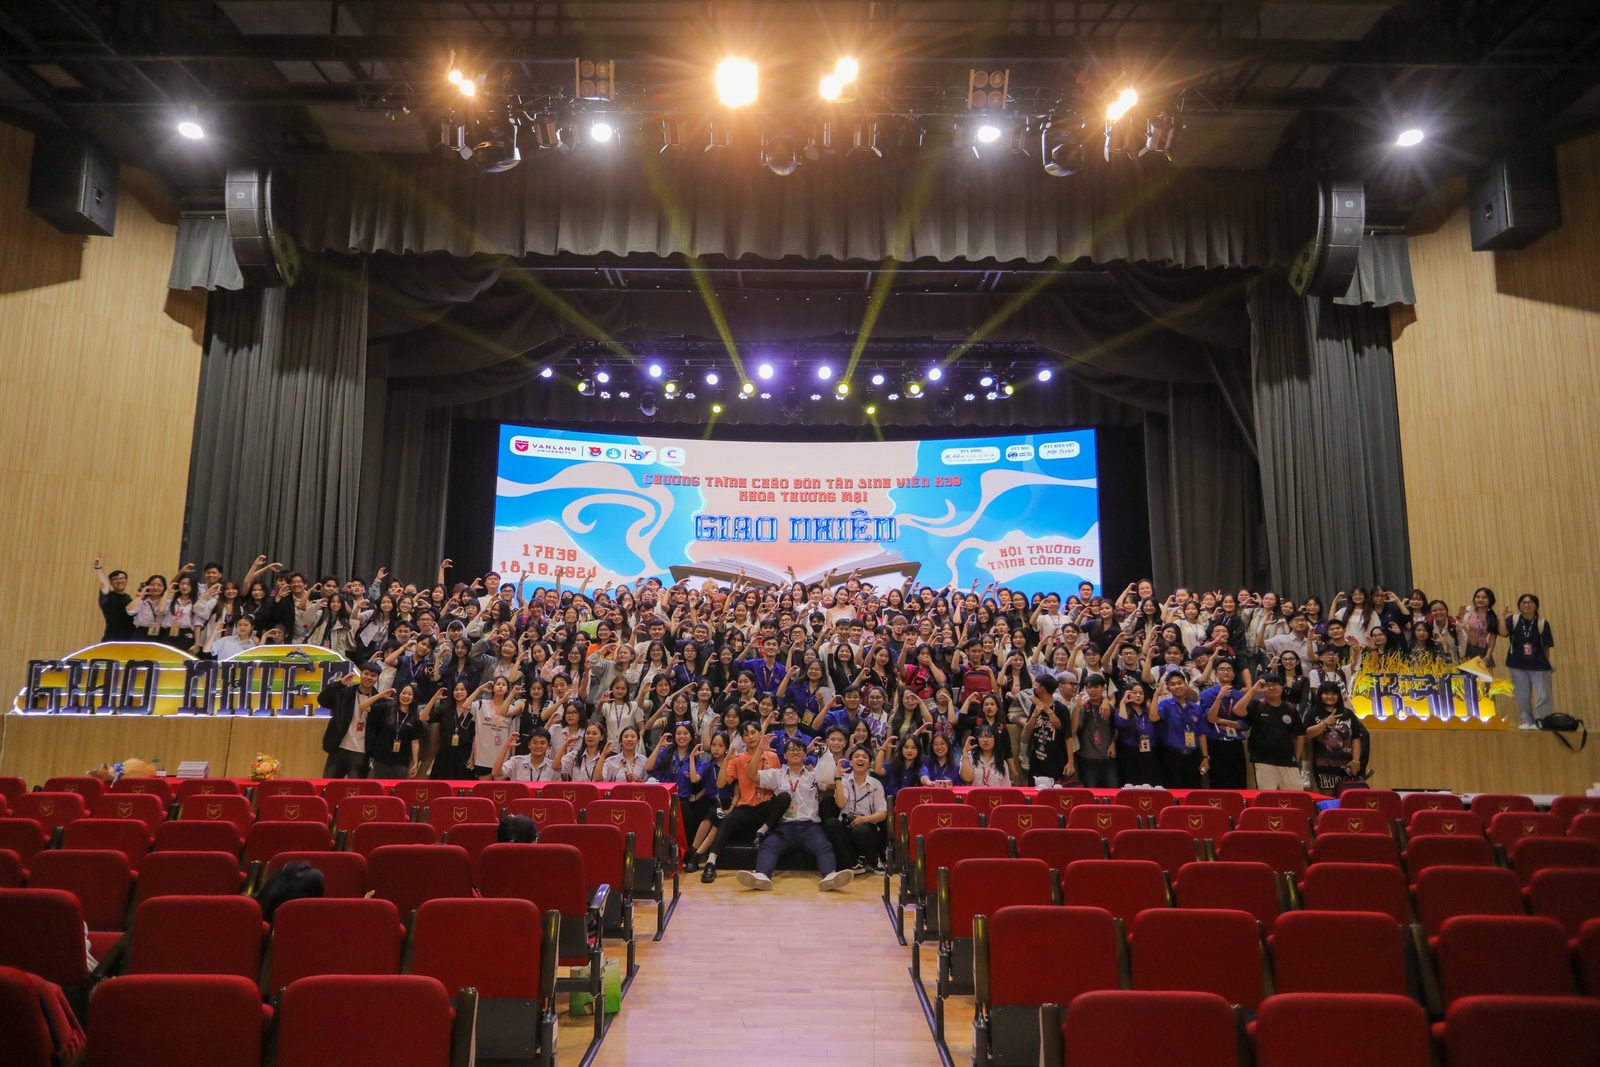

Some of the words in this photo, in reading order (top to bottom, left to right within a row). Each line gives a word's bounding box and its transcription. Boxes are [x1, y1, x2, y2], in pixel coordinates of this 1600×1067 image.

[858, 477, 891, 488] SINH
[739, 490, 776, 502] KHOA
[694, 515, 778, 542] GIAO
[788, 508, 897, 543] NHIÊN
[25, 658, 160, 715] GIAO
